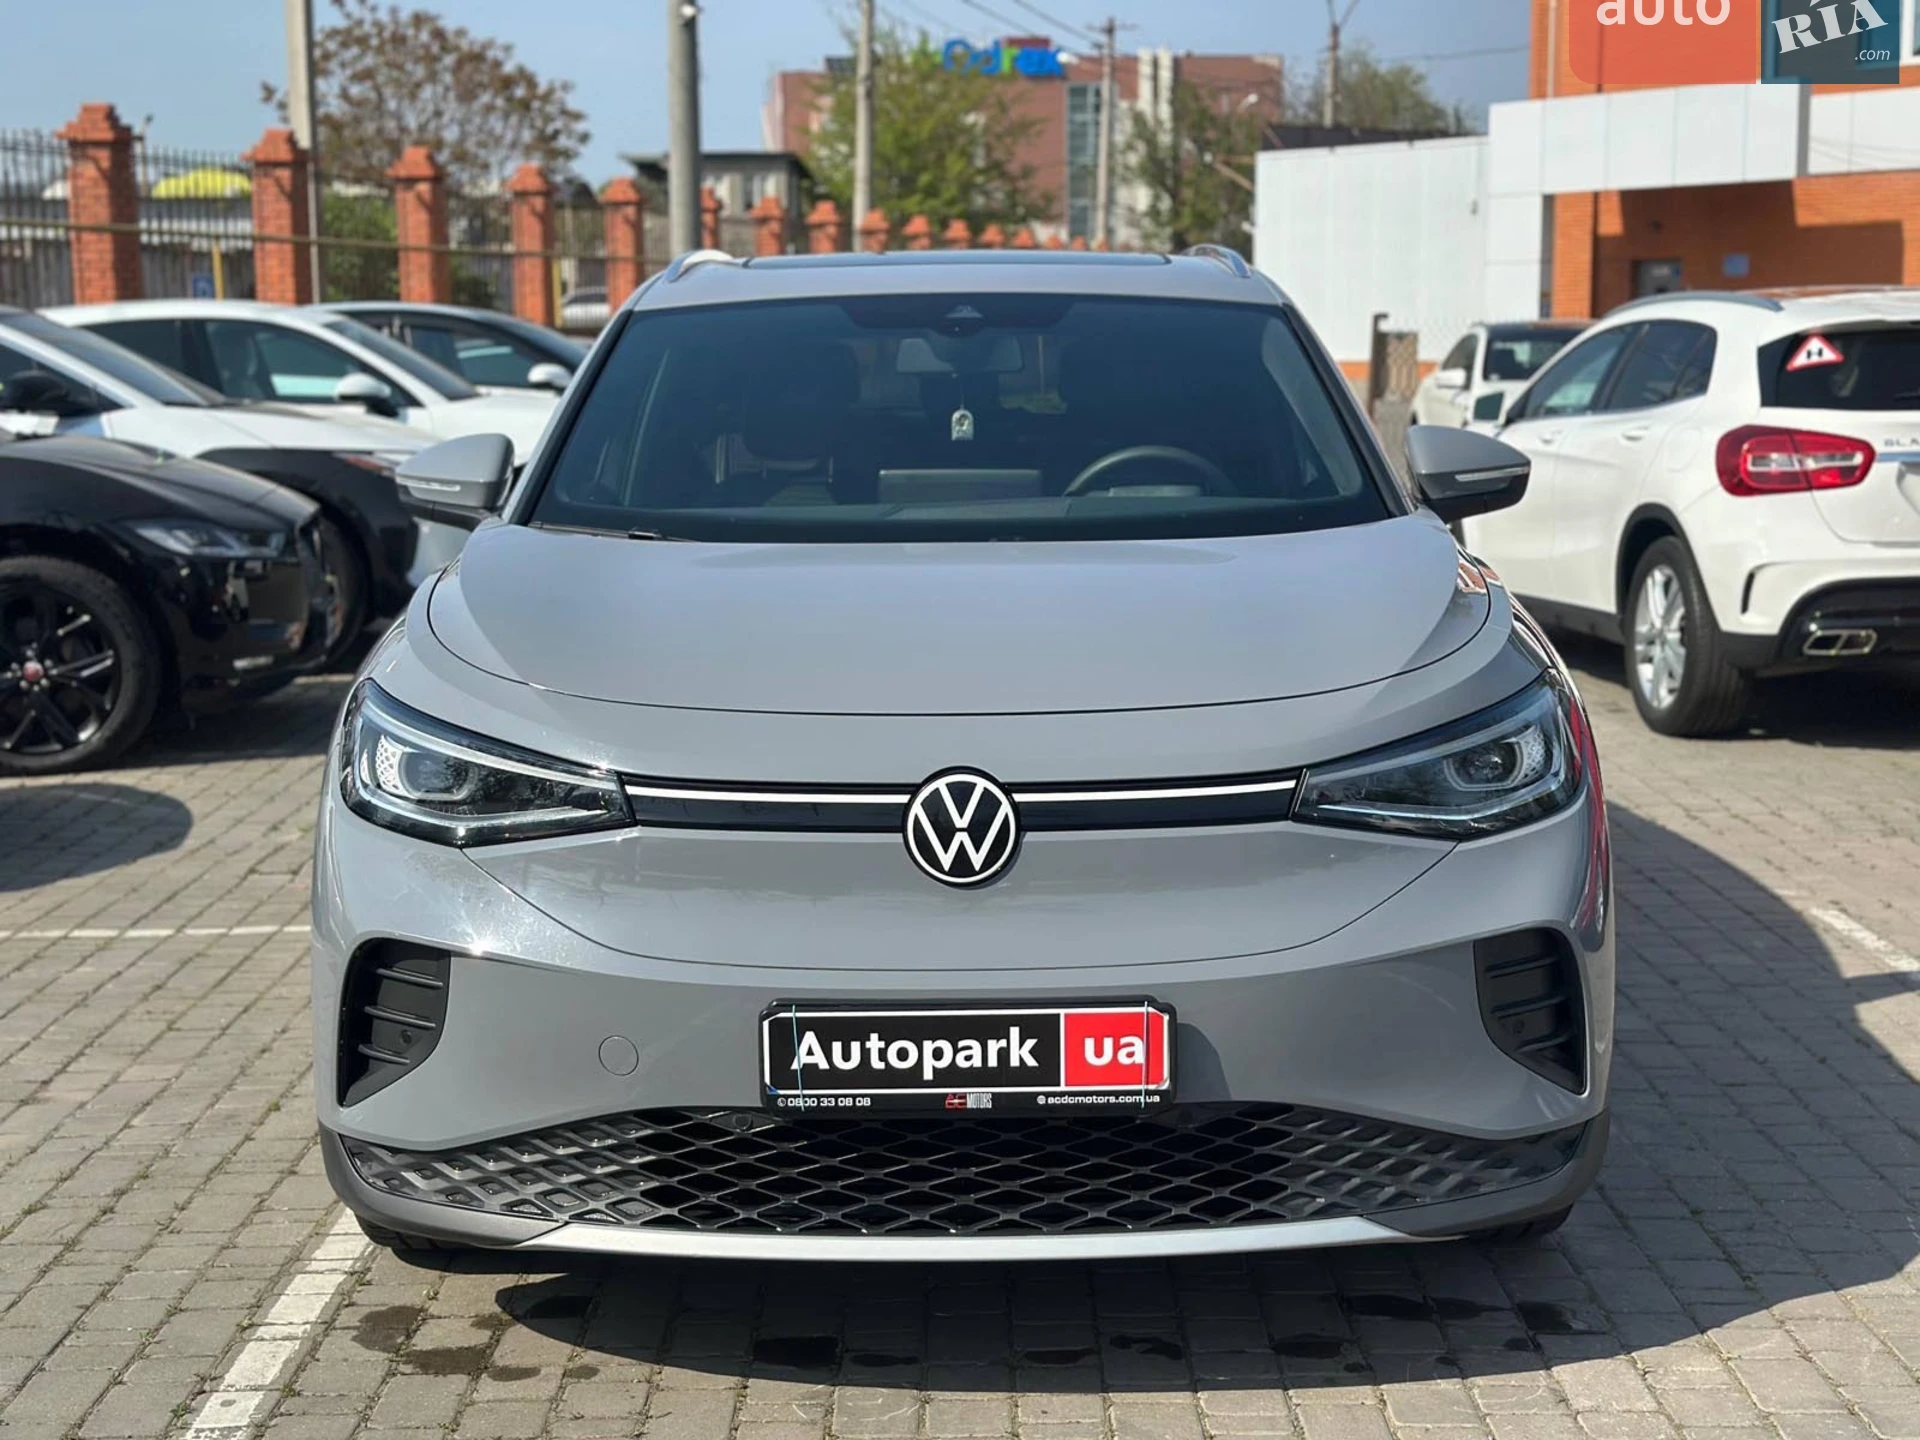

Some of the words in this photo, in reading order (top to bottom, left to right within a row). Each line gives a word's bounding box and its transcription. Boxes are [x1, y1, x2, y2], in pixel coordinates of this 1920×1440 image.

[790, 1026, 1039, 1080] Autopark
[1084, 1034, 1144, 1066] ua
[787, 1097, 818, 1107] 0800
[820, 1097, 835, 1107] 33
[838, 1097, 853, 1106] 08
[855, 1096, 871, 1106] 08
[1047, 1094, 1161, 1104] acdcmotors.comua
